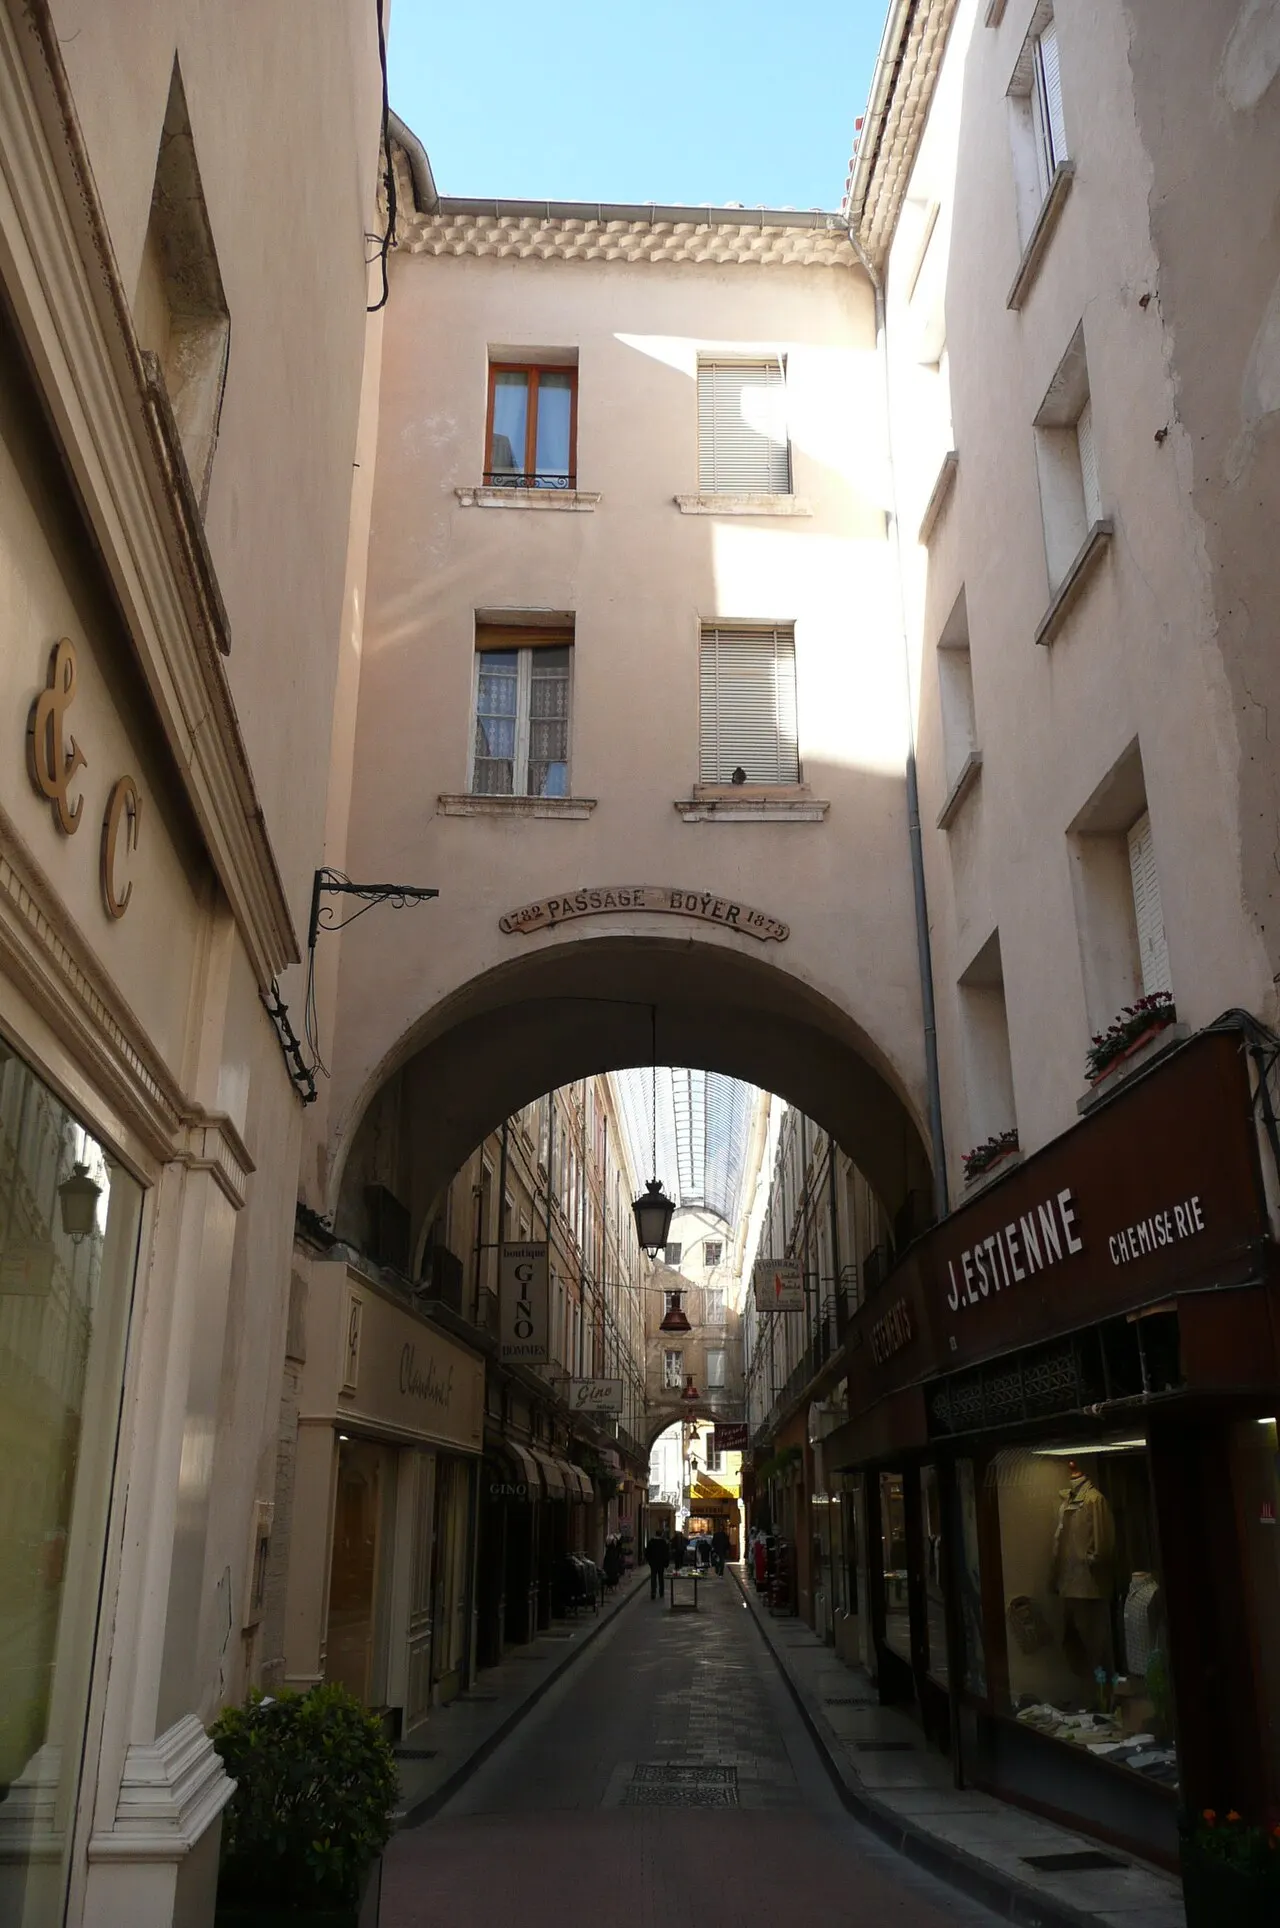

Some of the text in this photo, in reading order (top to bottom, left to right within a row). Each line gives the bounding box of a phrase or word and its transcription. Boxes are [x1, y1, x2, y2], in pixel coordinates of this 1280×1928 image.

[503, 889, 788, 938] 1782 PASSAGE BOYER 1875
[503, 1248, 545, 1259] boutique
[514, 1263, 534, 1339] GINO
[502, 1345, 545, 1356] HOMMES
[576, 1384, 612, 1408] Gino
[490, 1484, 527, 1495] GINO
